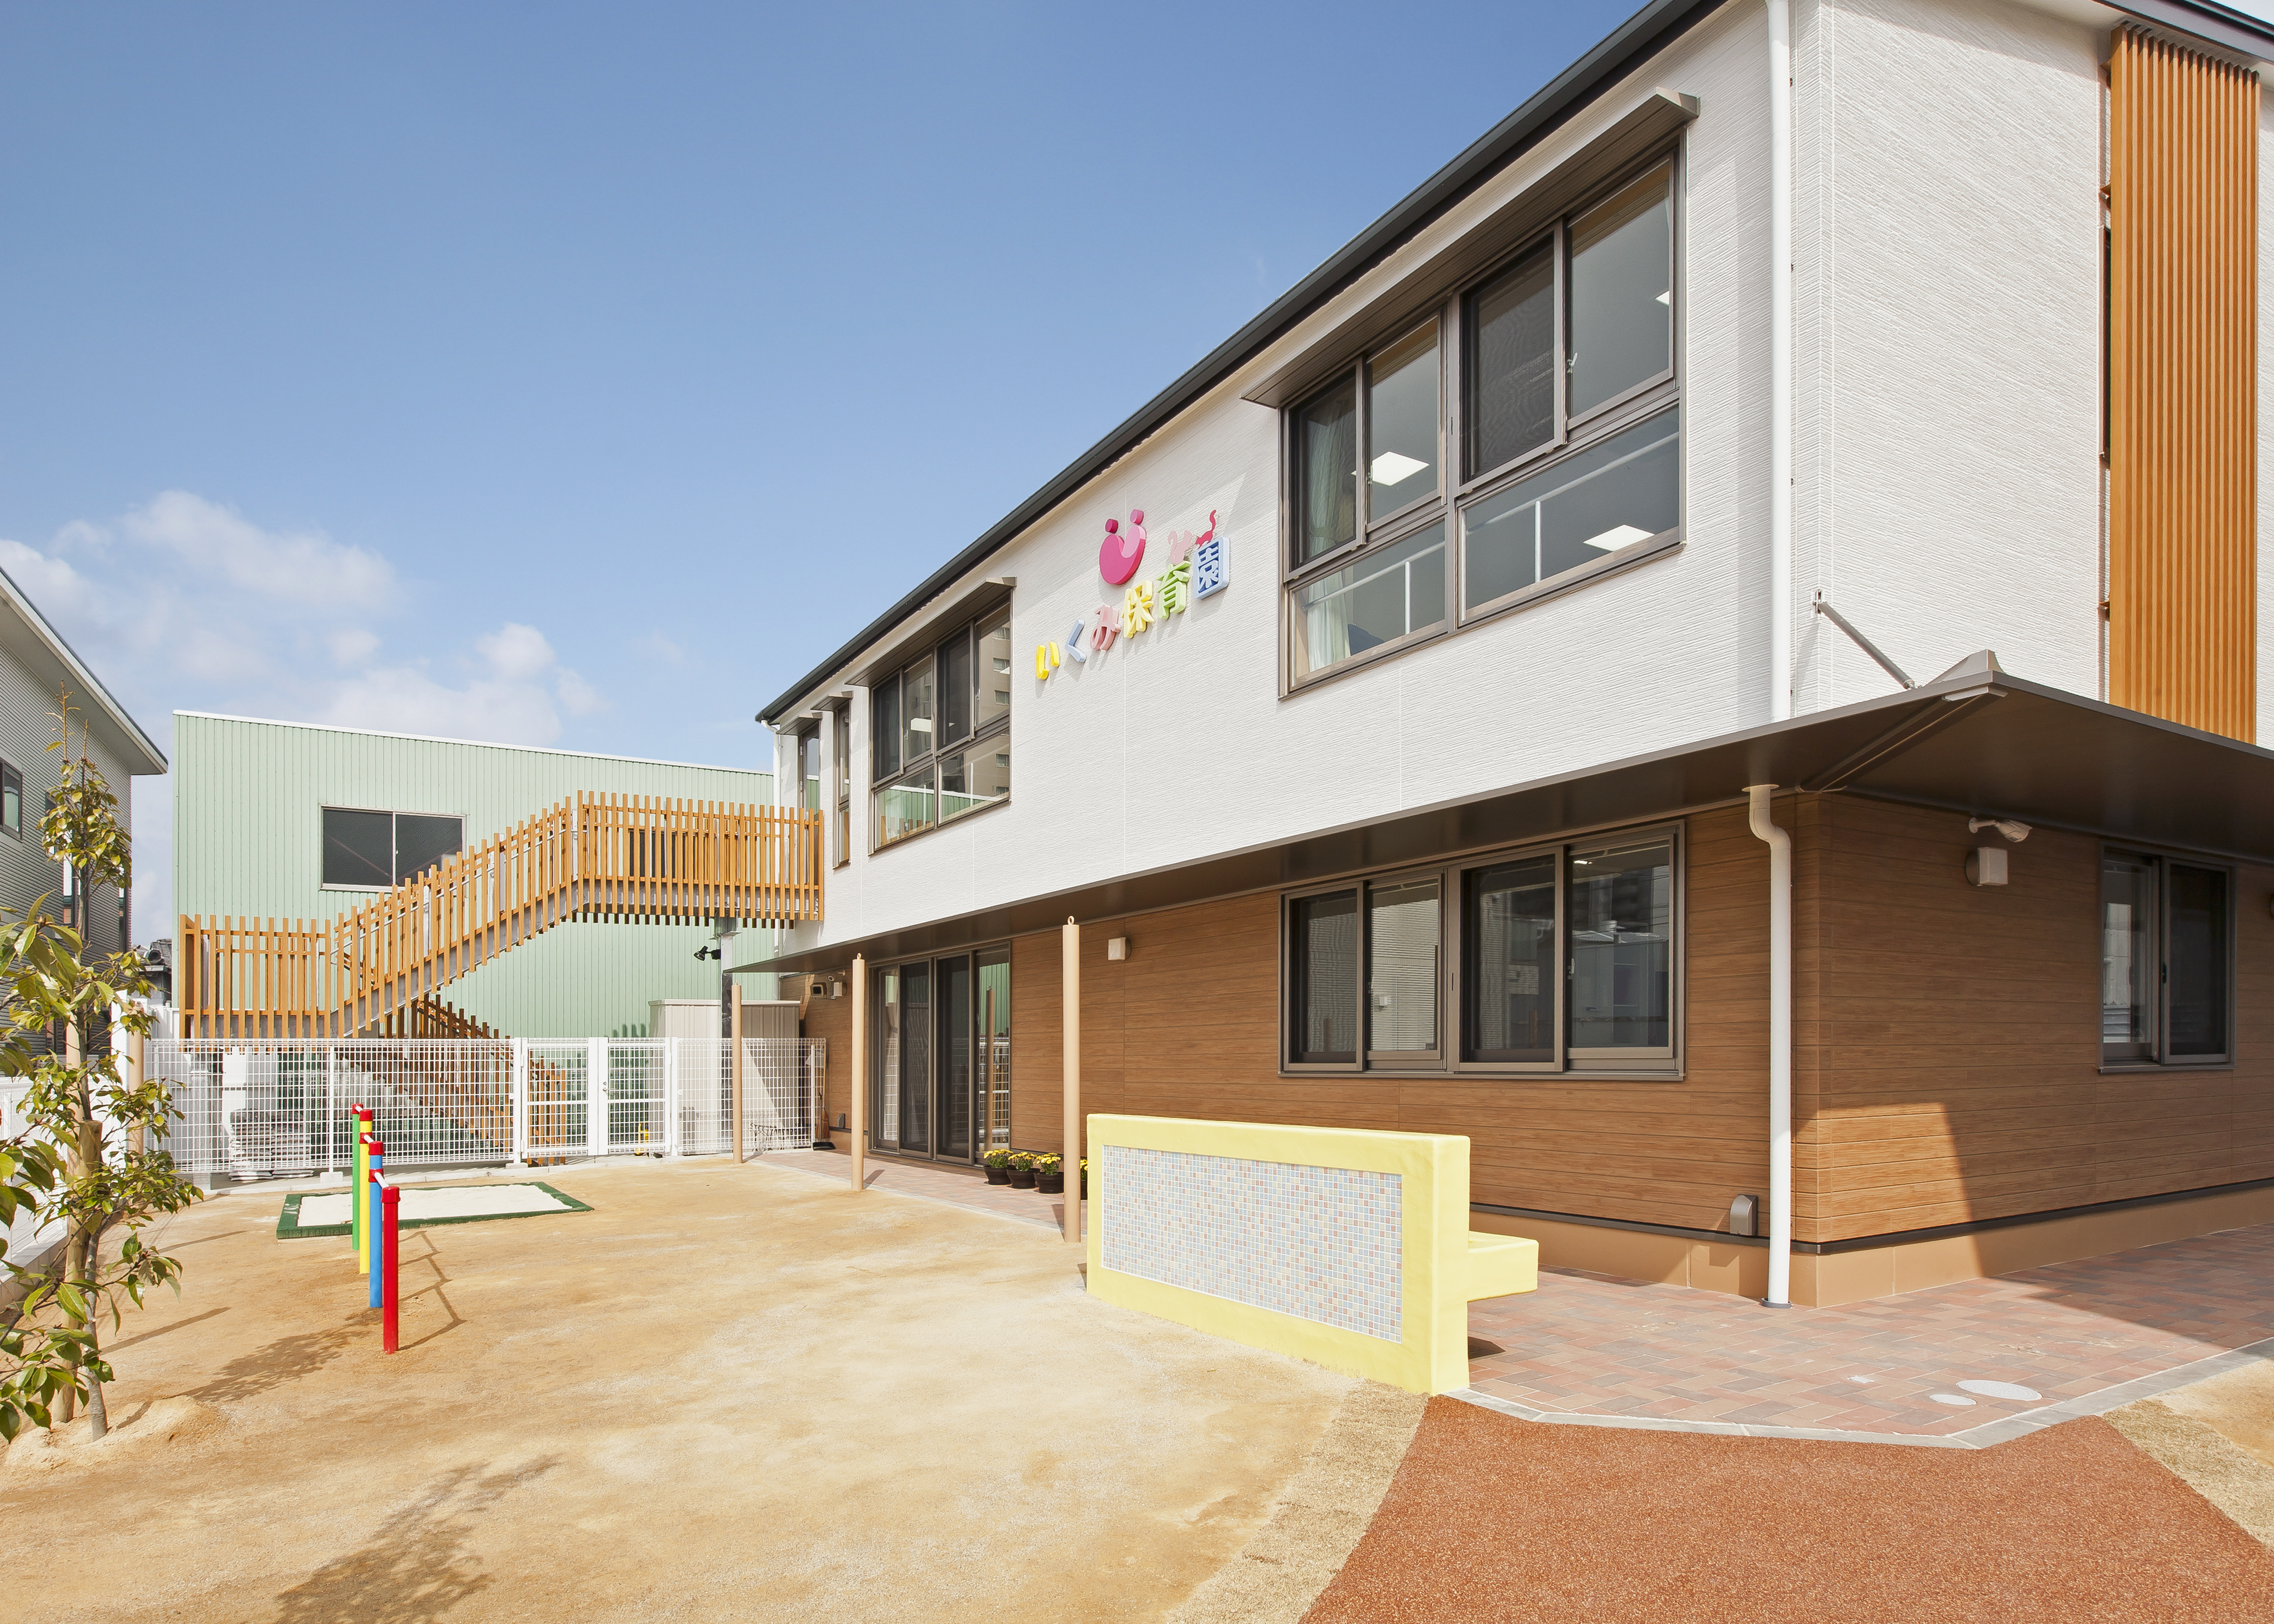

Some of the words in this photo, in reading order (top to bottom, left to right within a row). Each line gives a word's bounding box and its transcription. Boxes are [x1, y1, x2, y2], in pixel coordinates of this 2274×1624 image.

[1036, 537, 1230, 680] いくみ保育園
